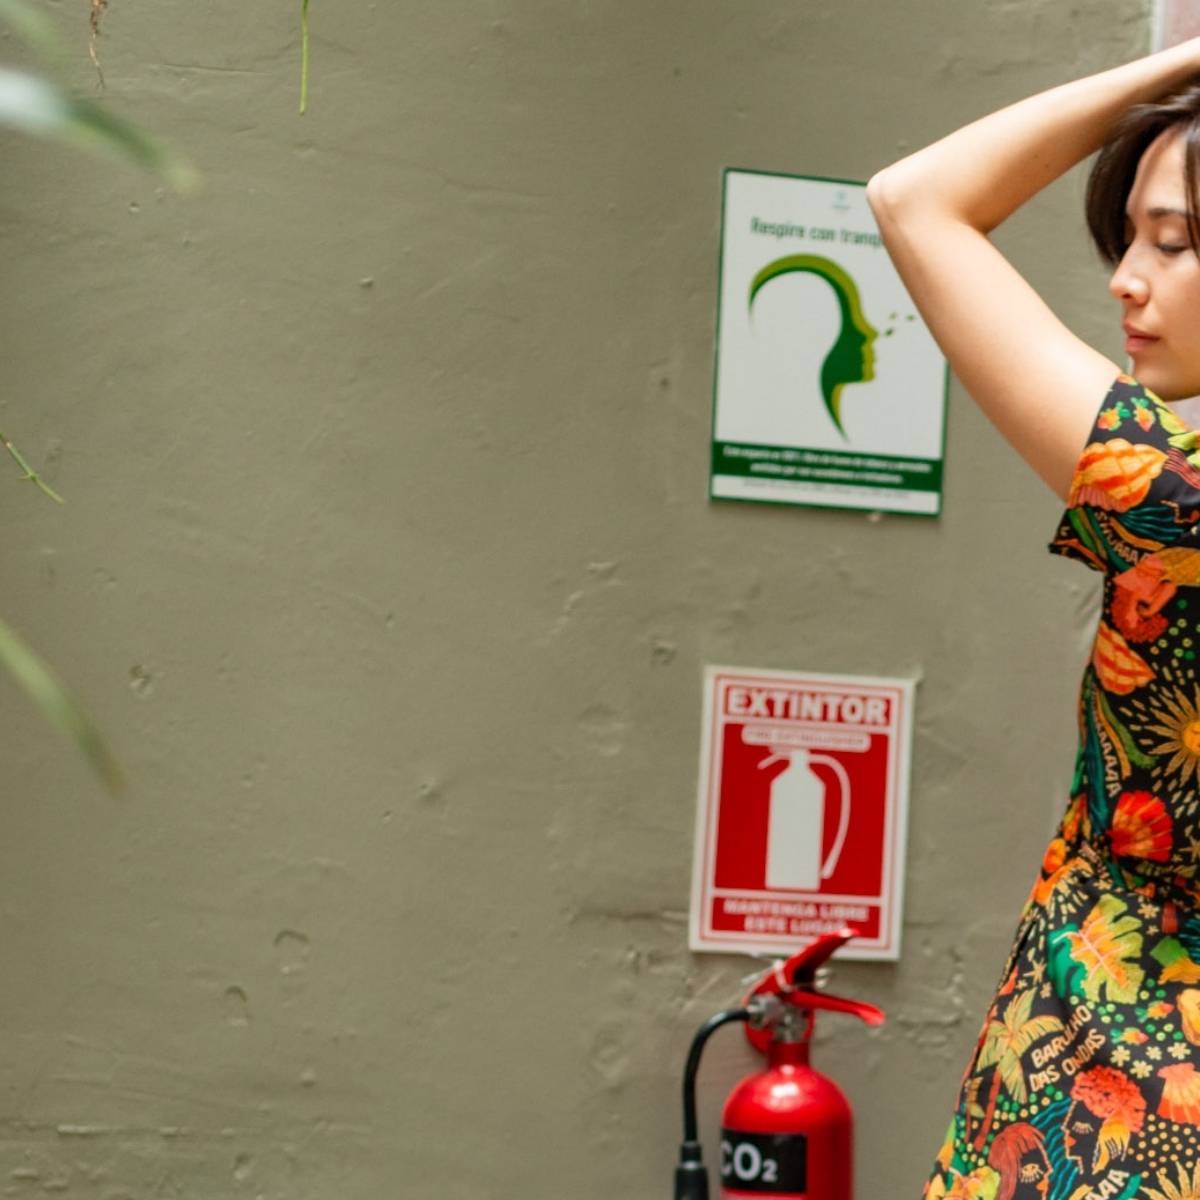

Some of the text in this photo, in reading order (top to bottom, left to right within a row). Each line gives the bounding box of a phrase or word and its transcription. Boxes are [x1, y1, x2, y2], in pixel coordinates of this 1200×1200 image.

[750, 216, 883, 249] Respire con tranq
[726, 688, 888, 725] EXTINTOR
[723, 898, 818, 918] MANTENGA
[744, 915, 787, 932] ESTE
[1032, 1004, 1093, 1069] BARULHO
[1029, 1028, 1107, 1093] DAS ONDAS
